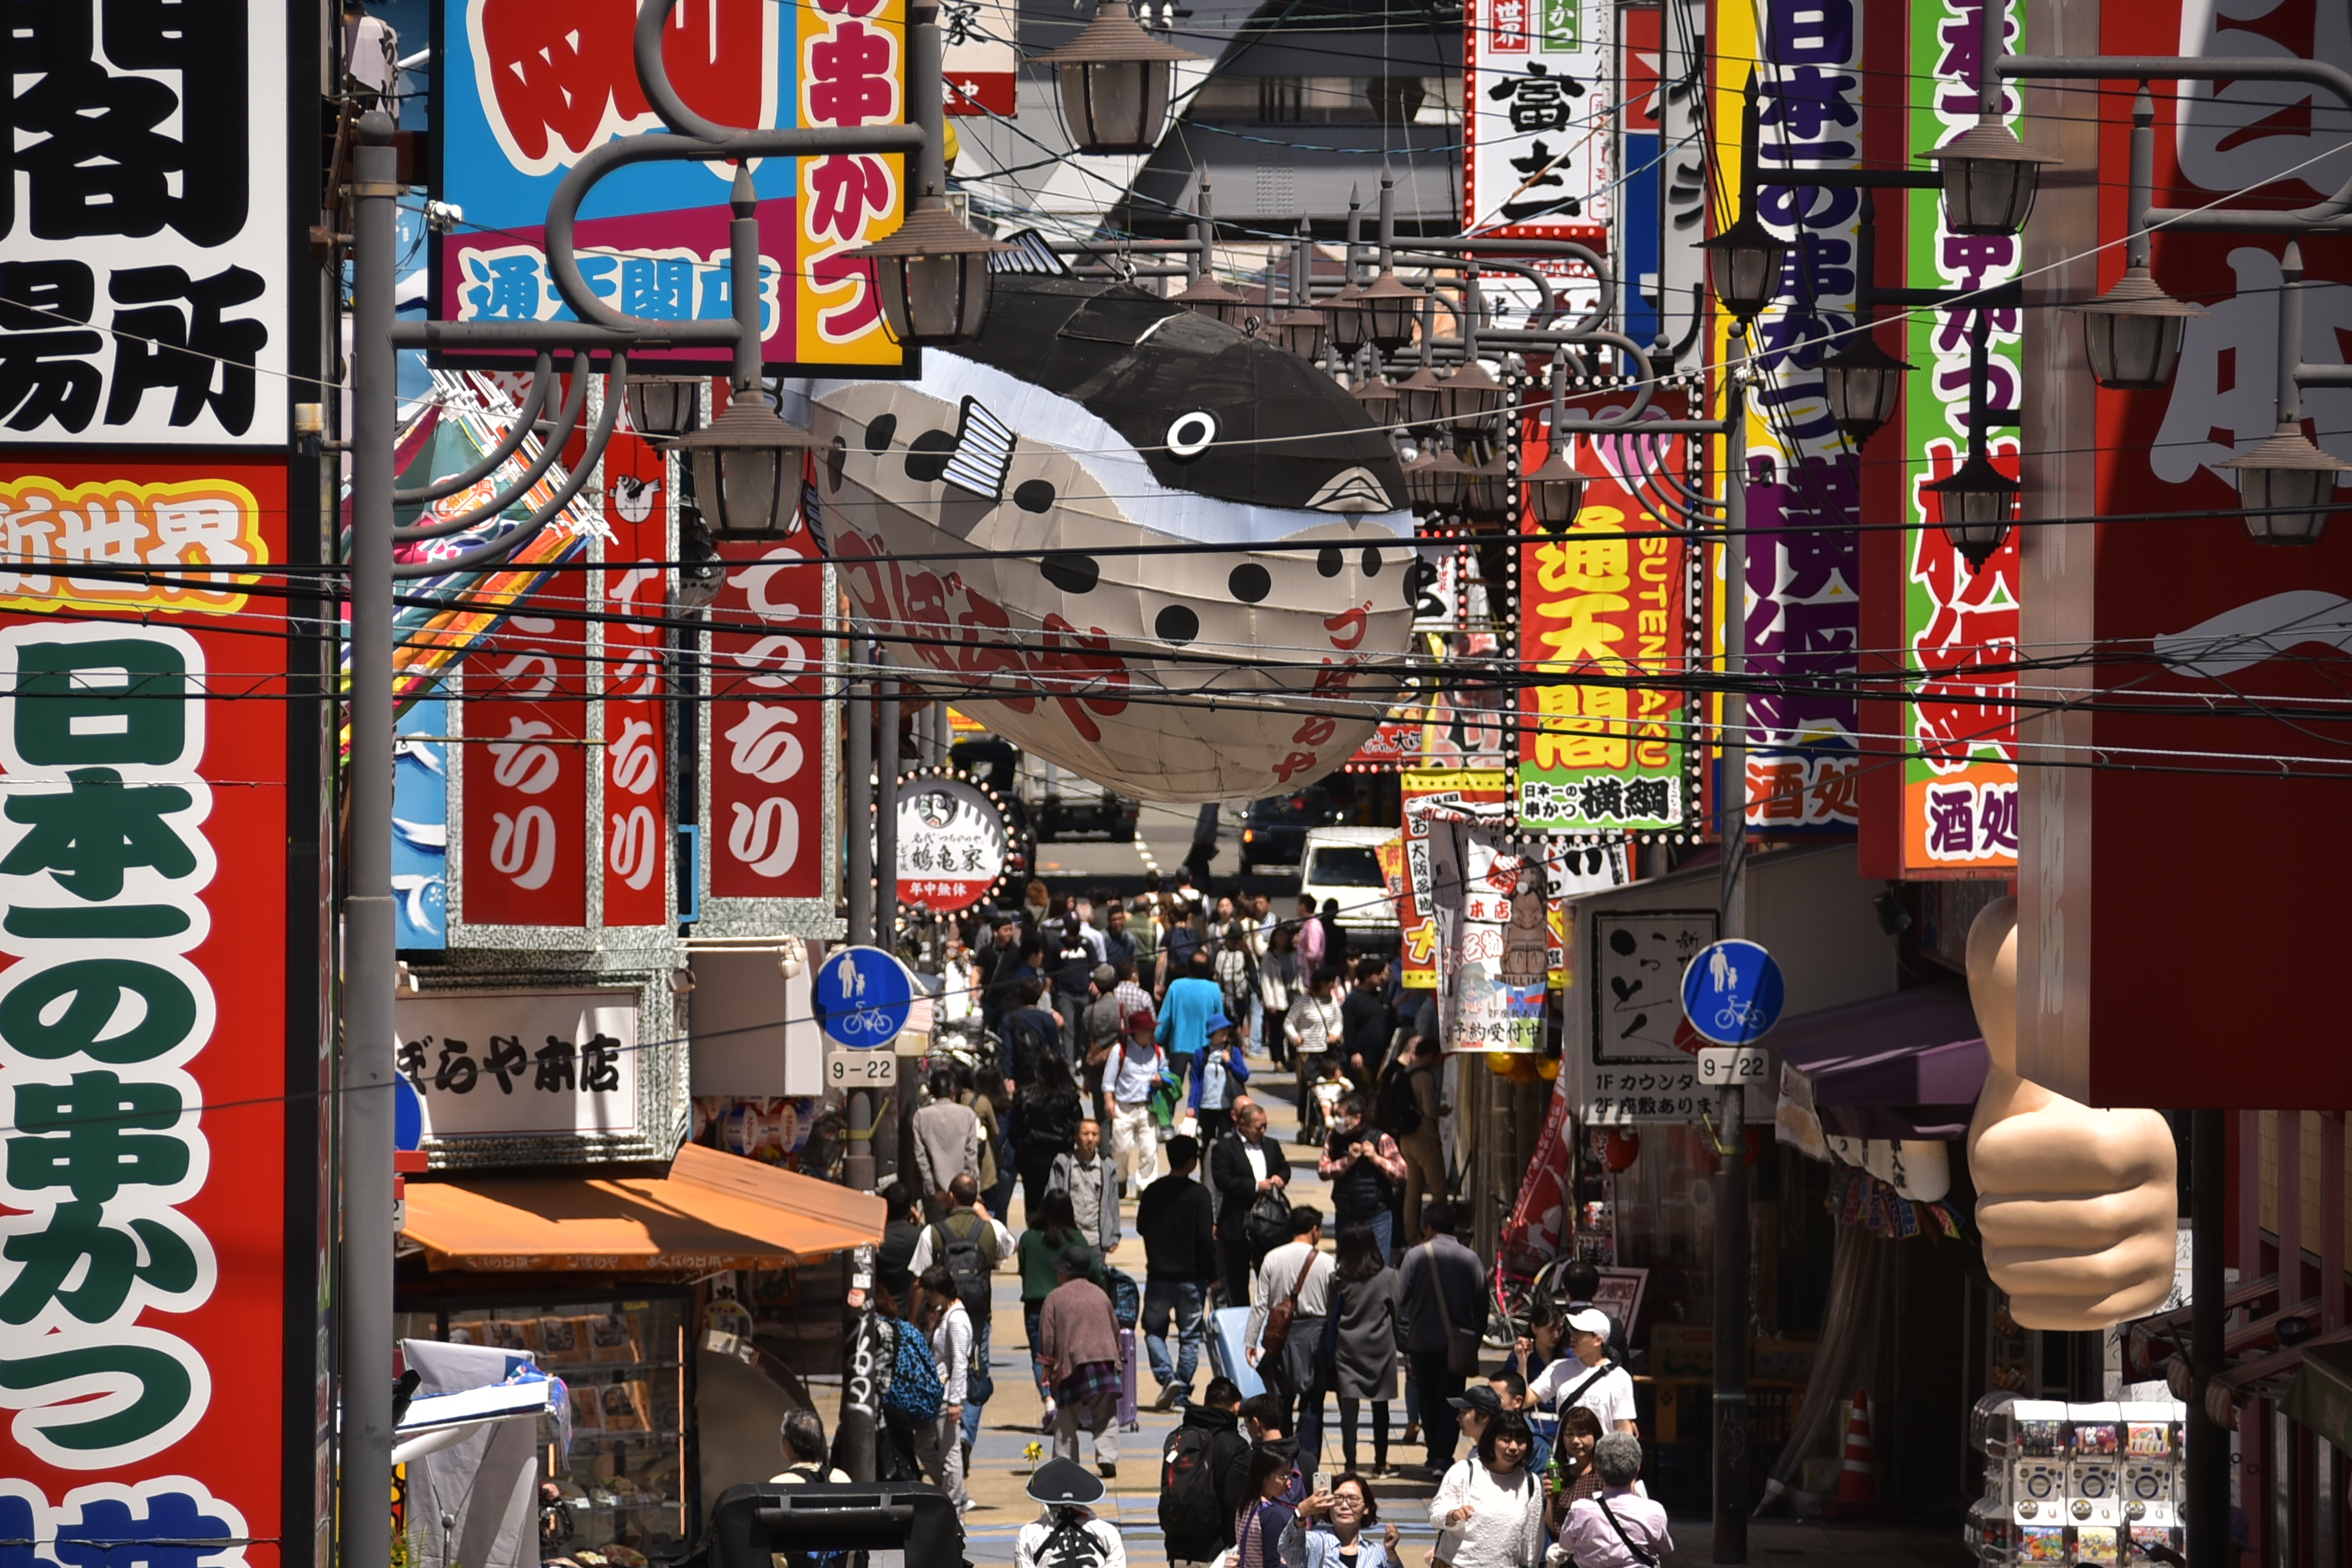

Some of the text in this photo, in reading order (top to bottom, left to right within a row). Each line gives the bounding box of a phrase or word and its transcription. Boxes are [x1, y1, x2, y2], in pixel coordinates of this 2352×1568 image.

[1548, 0, 1575, 44] かつ
[1488, 60, 1586, 221] 富士
[809, 0, 889, 338] 串かつ
[1534, 505, 1633, 768] 通天閣
[724, 547, 807, 878] てっちり
[1524, 784, 1578, 798] 日本一の
[1525, 801, 1577, 819] 串かつ
[1579, 777, 1670, 821] 横綱
[911, 843, 986, 872] 鶴亀家
[1411, 843, 1432, 912] 大阪名物
[909, 881, 968, 897] 年中無休
[1469, 899, 1510, 920] 本店
[0, 637, 199, 1451] 日本一の串かつ
[1596, 1074, 1614, 1090] 1F
[1594, 1097, 1720, 1114] 2F 座敷ありま
